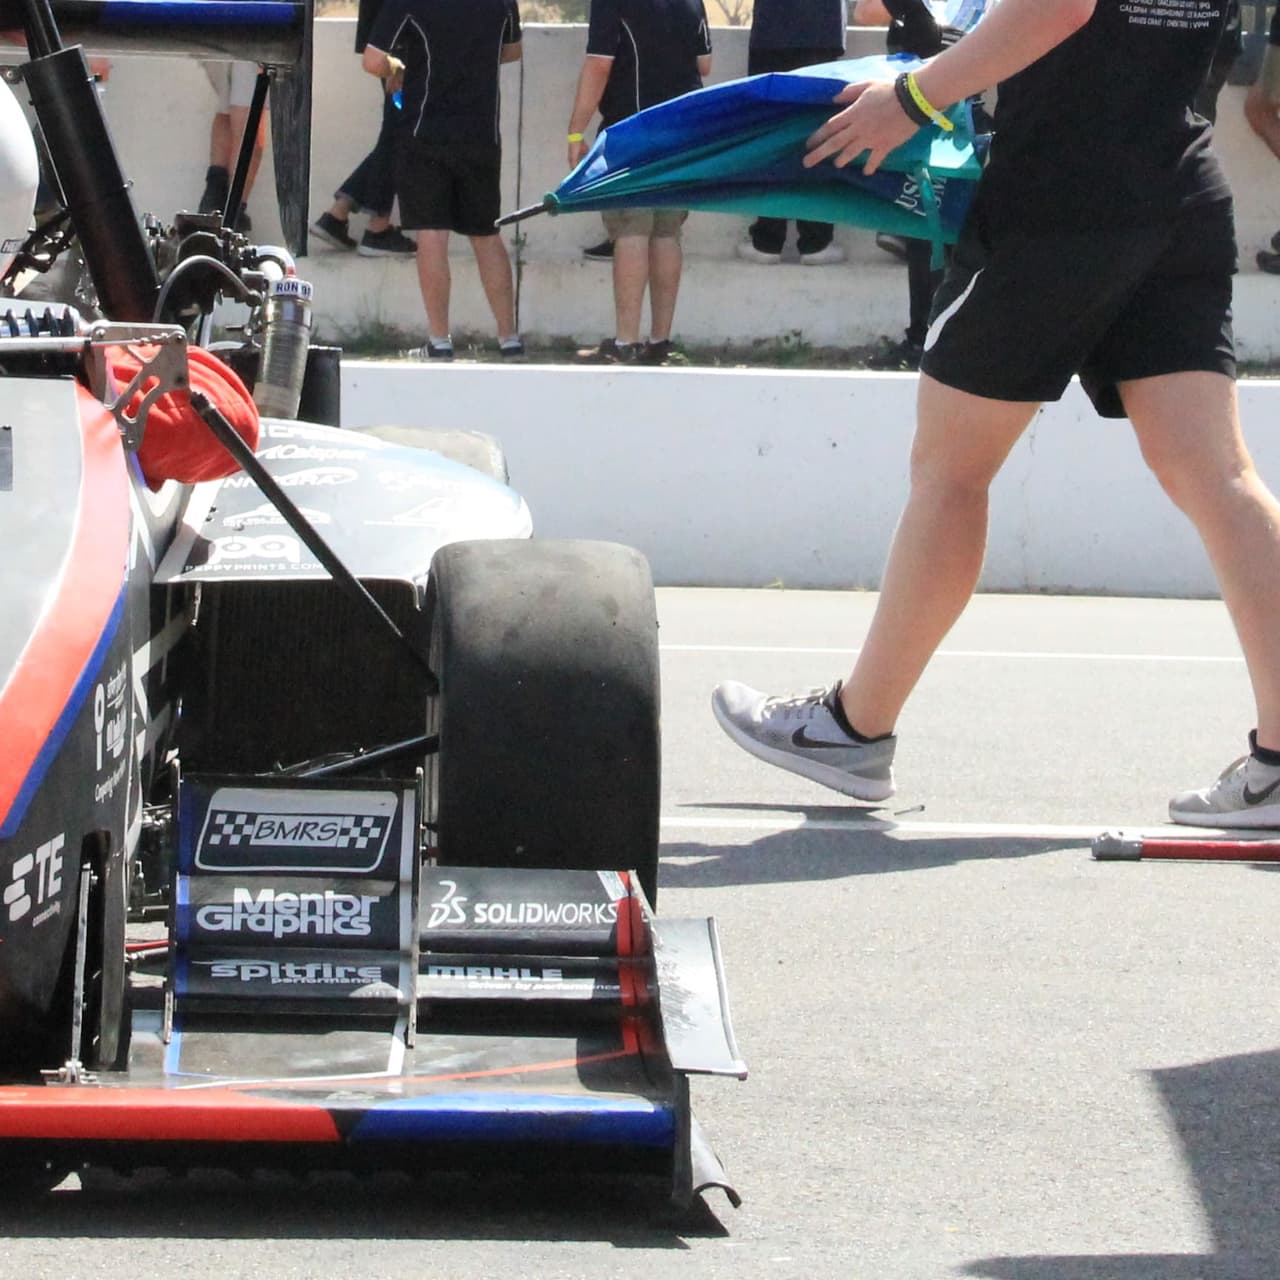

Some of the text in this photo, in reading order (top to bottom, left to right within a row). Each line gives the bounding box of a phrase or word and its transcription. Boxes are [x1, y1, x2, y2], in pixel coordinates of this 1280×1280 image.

[254, 820, 338, 841] BMRS
[233, 887, 380, 916] Mentor
[196, 904, 372, 939] Graphics
[473, 902, 619, 924] SOLIDWORKS
[210, 962, 382, 982] spitfire
[427, 965, 563, 982] MAHLE
